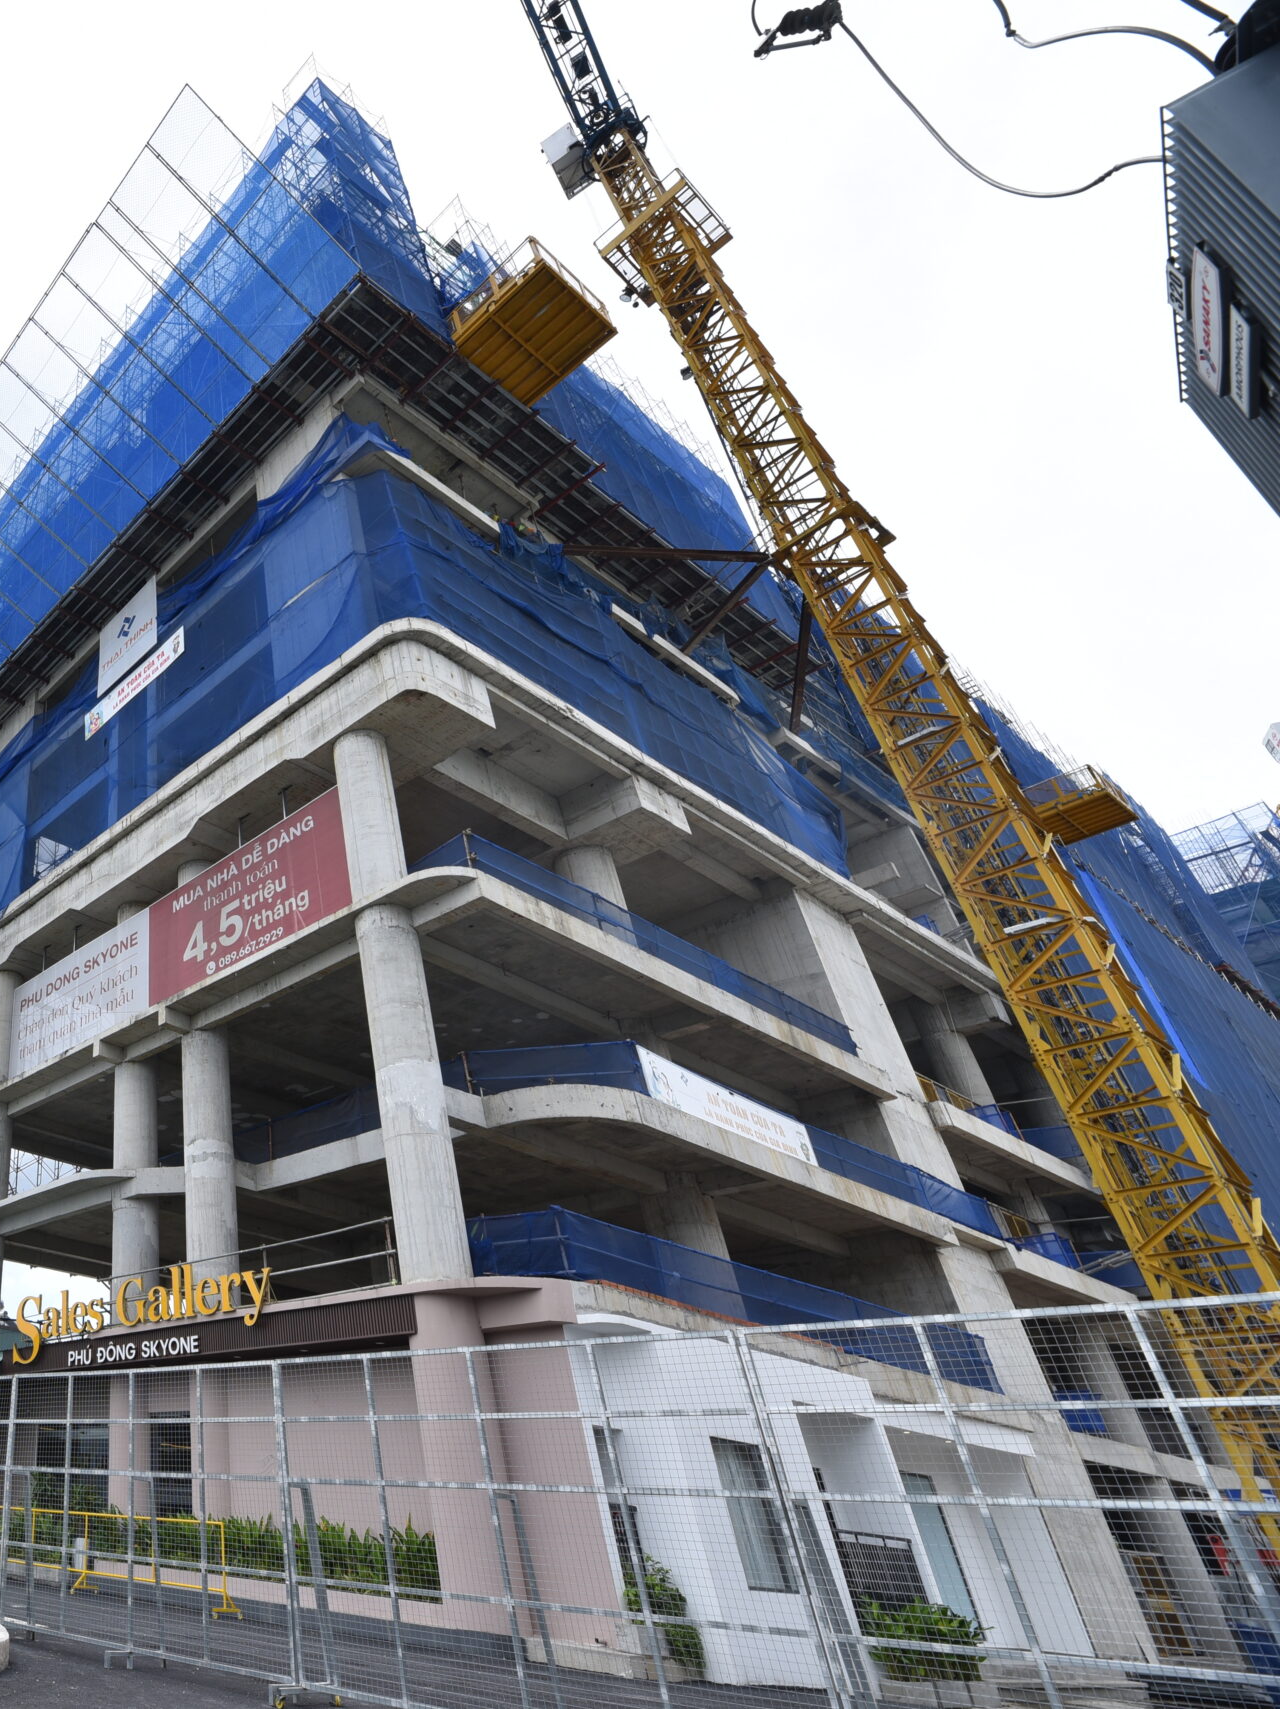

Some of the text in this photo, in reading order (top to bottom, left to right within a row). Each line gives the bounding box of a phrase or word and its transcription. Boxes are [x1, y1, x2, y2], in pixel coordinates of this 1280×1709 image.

[1169, 270, 1184, 311] 320
[1201, 277, 1212, 352] SANAKY
[1235, 319, 1245, 403] AMORPHOUS
[172, 815, 314, 913] MUA NHÀ DỄ DÀNG
[203, 859, 279, 911] thanh toán
[183, 876, 287, 963] 4,5 triệu
[245, 889, 310, 937] /tháng
[20, 931, 138, 1012] PHU DONG SKYONE
[99, 963, 138, 995] khách
[218, 926, 284, 969] 089.667.2929
[12, 1263, 272, 1365] Sales Gallery
[67, 1335, 199, 1367] PHÚ ĐÔNG SKYONE
